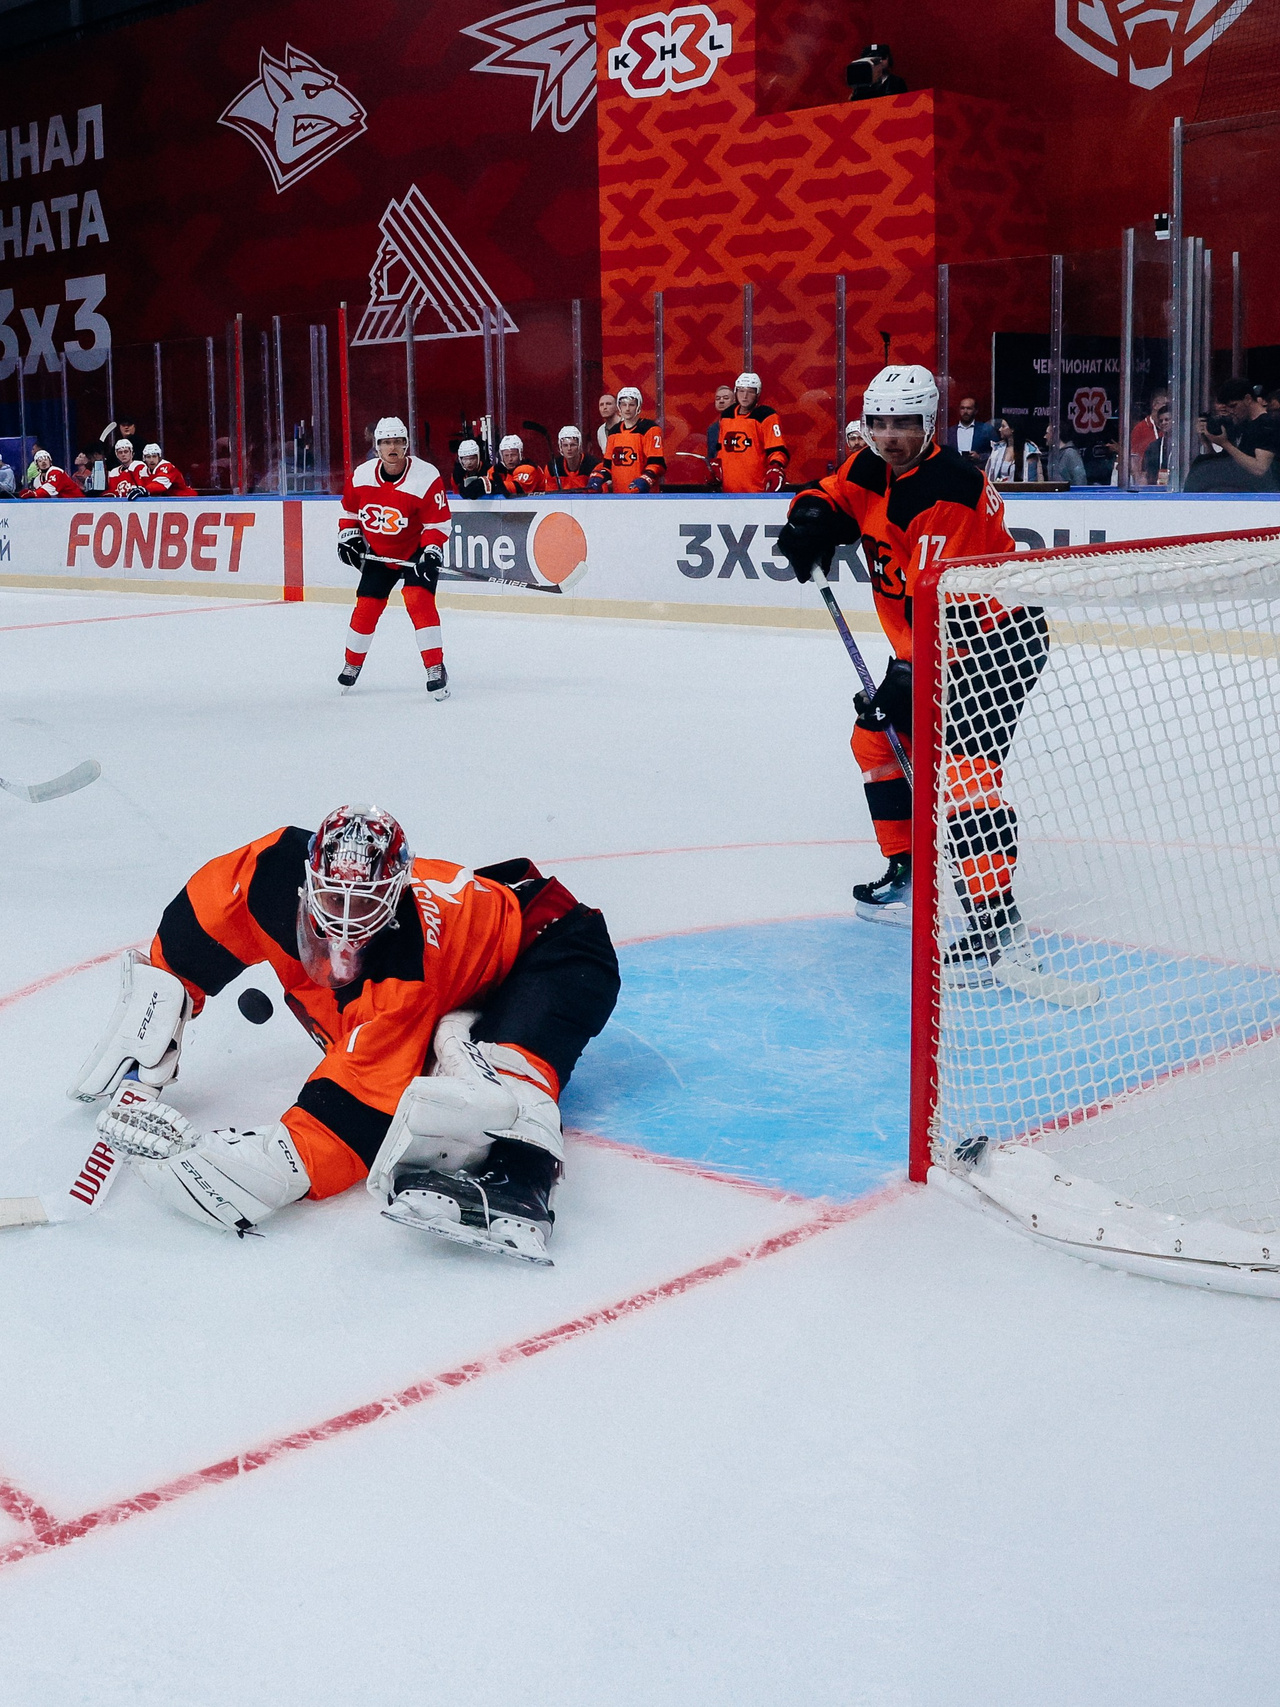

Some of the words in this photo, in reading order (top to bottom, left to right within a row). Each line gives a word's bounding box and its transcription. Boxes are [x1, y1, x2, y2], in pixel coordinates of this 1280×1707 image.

[886, 374, 901, 382] 17
[66, 512, 256, 572] FONBET
[463, 1041, 502, 1086] CCM
[277, 1139, 298, 1173] CCM
